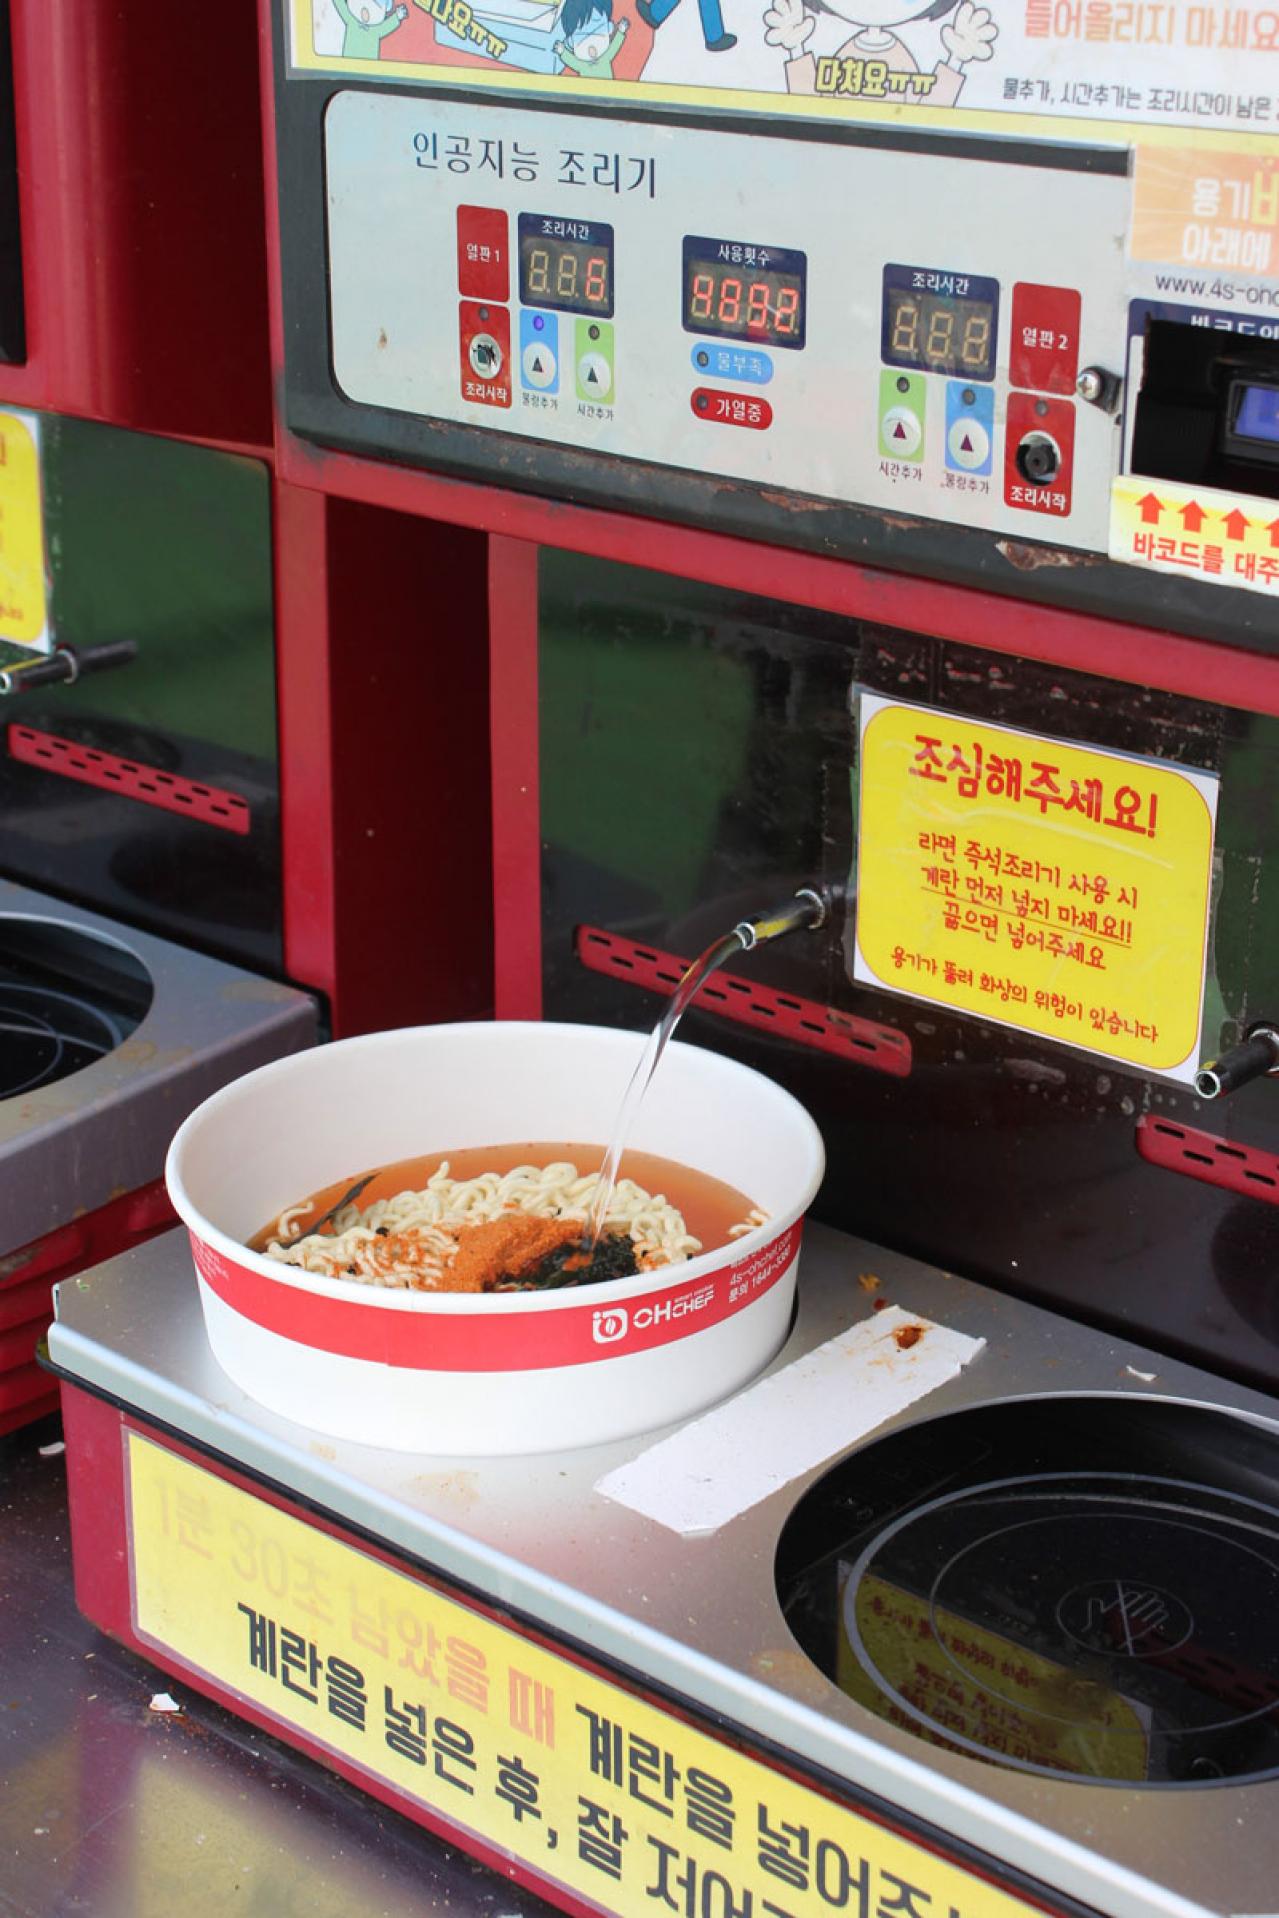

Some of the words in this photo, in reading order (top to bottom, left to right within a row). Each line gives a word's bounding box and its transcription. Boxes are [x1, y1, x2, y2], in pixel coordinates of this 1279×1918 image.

[1025, 0, 1175, 45] 들어올리지
[1060, 82, 1142, 110] 시간추가는
[1148, 88, 1231, 115] 조리시간이
[1236, 93, 1272, 120] 남은
[413, 132, 539, 182] 인공지능
[558, 150, 656, 198] 조리기
[542, 220, 590, 241] 조리시간
[1182, 222, 1272, 271] 아래에
[494, 250, 500, 263] 1
[718, 244, 771, 266] 사용횟수
[912, 272, 969, 295] 조리시간
[1022, 327, 1054, 349] 열판
[1058, 335, 1068, 350] 2
[466, 383, 507, 403] 조리시작
[717, 399, 762, 423] 가열중
[879, 461, 923, 481] 시간추가
[1010, 486, 1065, 511] 조리시작
[1132, 531, 1224, 575] 바코드를
[908, 734, 1158, 838] 조심해주세요!
[919, 832, 957, 863] 라면
[964, 840, 1061, 888] 즉석조리기
[1068, 873, 1111, 905] 사용
[1117, 886, 1138, 909] 시
[921, 866, 960, 898] 계란
[965, 876, 1003, 906] 먼저
[1012, 889, 1050, 919] 넣지
[943, 901, 999, 942] 끓으면
[1007, 922, 1107, 971] 넣어주세요
[892, 946, 938, 975] 용기가
[979, 972, 1029, 1003] 화상의
[1034, 990, 1083, 1021] 위험이
[1089, 1006, 1159, 1043] 있습니다
[229, 1517, 335, 1627] 30초
[347, 1581, 491, 1715] 남았을
[508, 1665, 555, 1750] 때
[575, 1702, 736, 1851] 계란을
[237, 1602, 368, 1733] 계란을
[384, 1685, 477, 1797] 넣은
[577, 1794, 629, 1882] 잘
